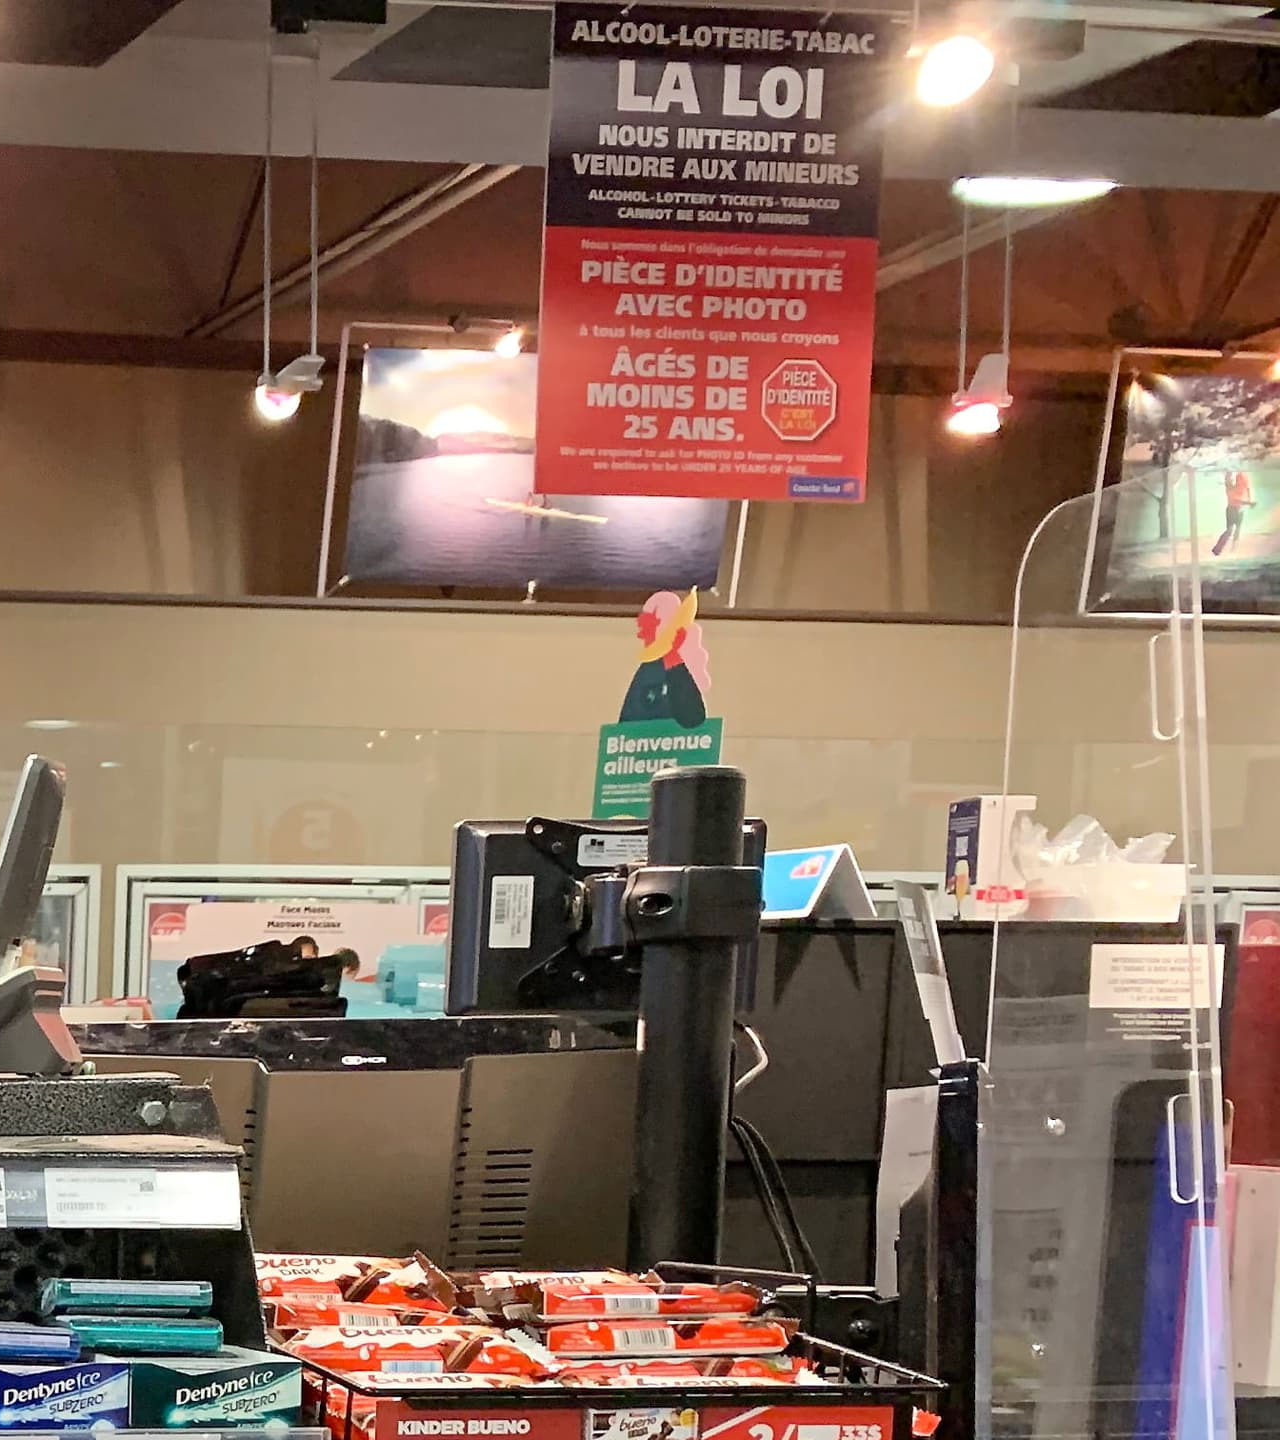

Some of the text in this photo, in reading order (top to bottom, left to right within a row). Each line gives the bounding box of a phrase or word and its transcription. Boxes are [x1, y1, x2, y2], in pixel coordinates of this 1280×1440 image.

[572, 19, 875, 55] ALCOOL-LOTERIE-TABAC
[617, 60, 824, 120] LA LOI
[599, 124, 837, 155] NOUS INTERDIT DE
[572, 153, 860, 185] VENDRE AUX MINEURS
[737, 211, 754, 223] TO
[581, 255, 843, 292] PIÈCE D'IDENTITÉ
[615, 293, 807, 321] AVEC PHOTO
[591, 325, 778, 346] tous les clients que nous
[611, 345, 749, 380] ÂGÉS DE
[782, 367, 818, 387] PIÈCE
[587, 382, 748, 411] MOINS DE
[623, 416, 745, 442] 25 ANS.
[607, 732, 712, 755] Bienvenue
[604, 756, 678, 776] ailleurs
[280, 1268, 324, 1277] DARK
[3, 1370, 101, 1406] Dentyne Ice
[176, 1369, 274, 1405] Dentyne Ice
[397, 1419, 531, 1436] KINDER BUENO
[619, 1415, 657, 1432] bueno
